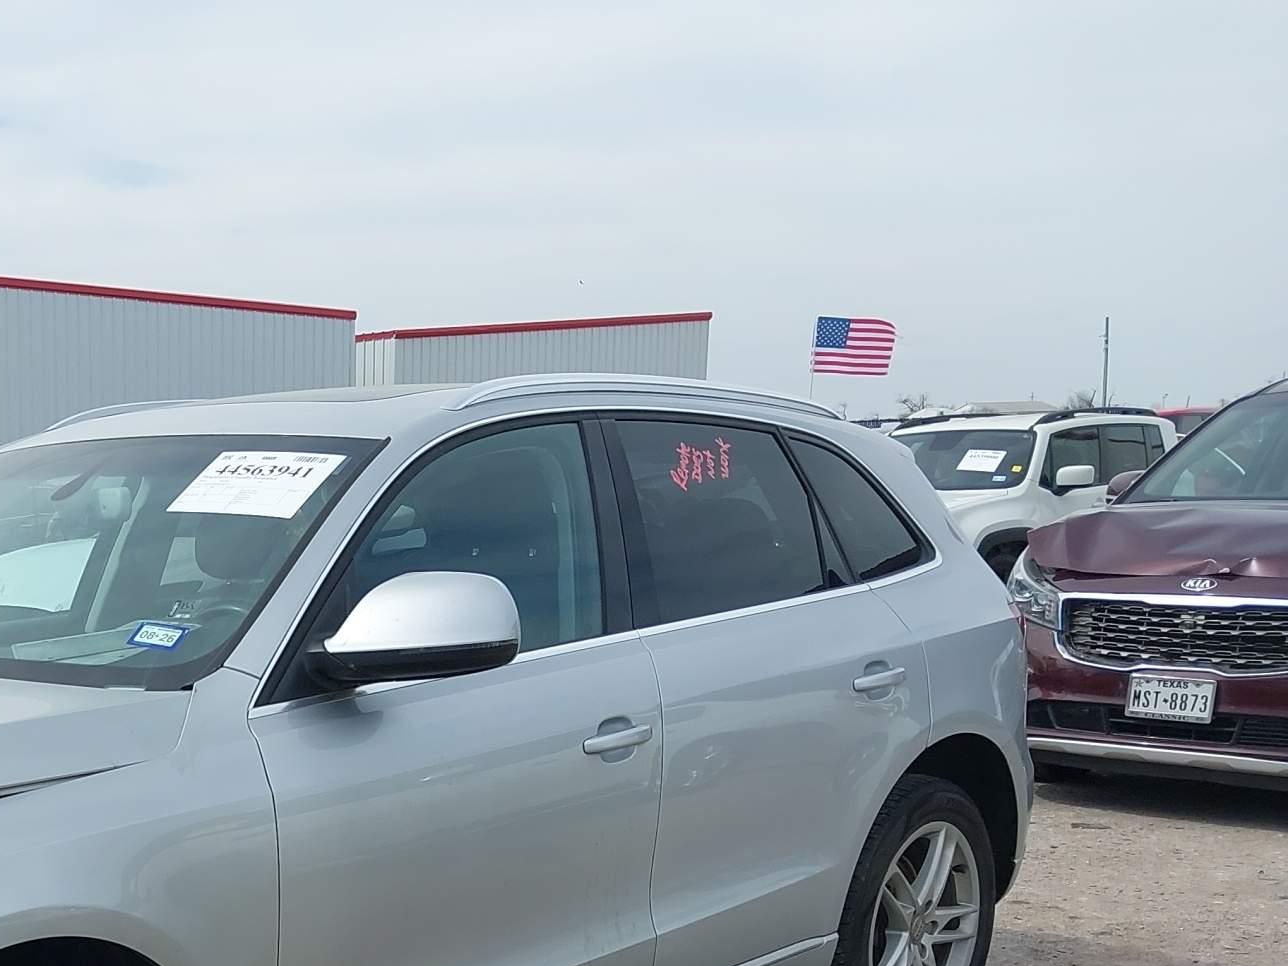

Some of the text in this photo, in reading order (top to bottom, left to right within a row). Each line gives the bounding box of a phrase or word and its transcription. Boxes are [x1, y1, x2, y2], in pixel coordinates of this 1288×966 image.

[215, 464, 314, 478] 44563941
[1185, 579, 1210, 588] KIA
[1156, 680, 1189, 689] TEXAS
[1144, 713, 1189, 721] CLASSIC
